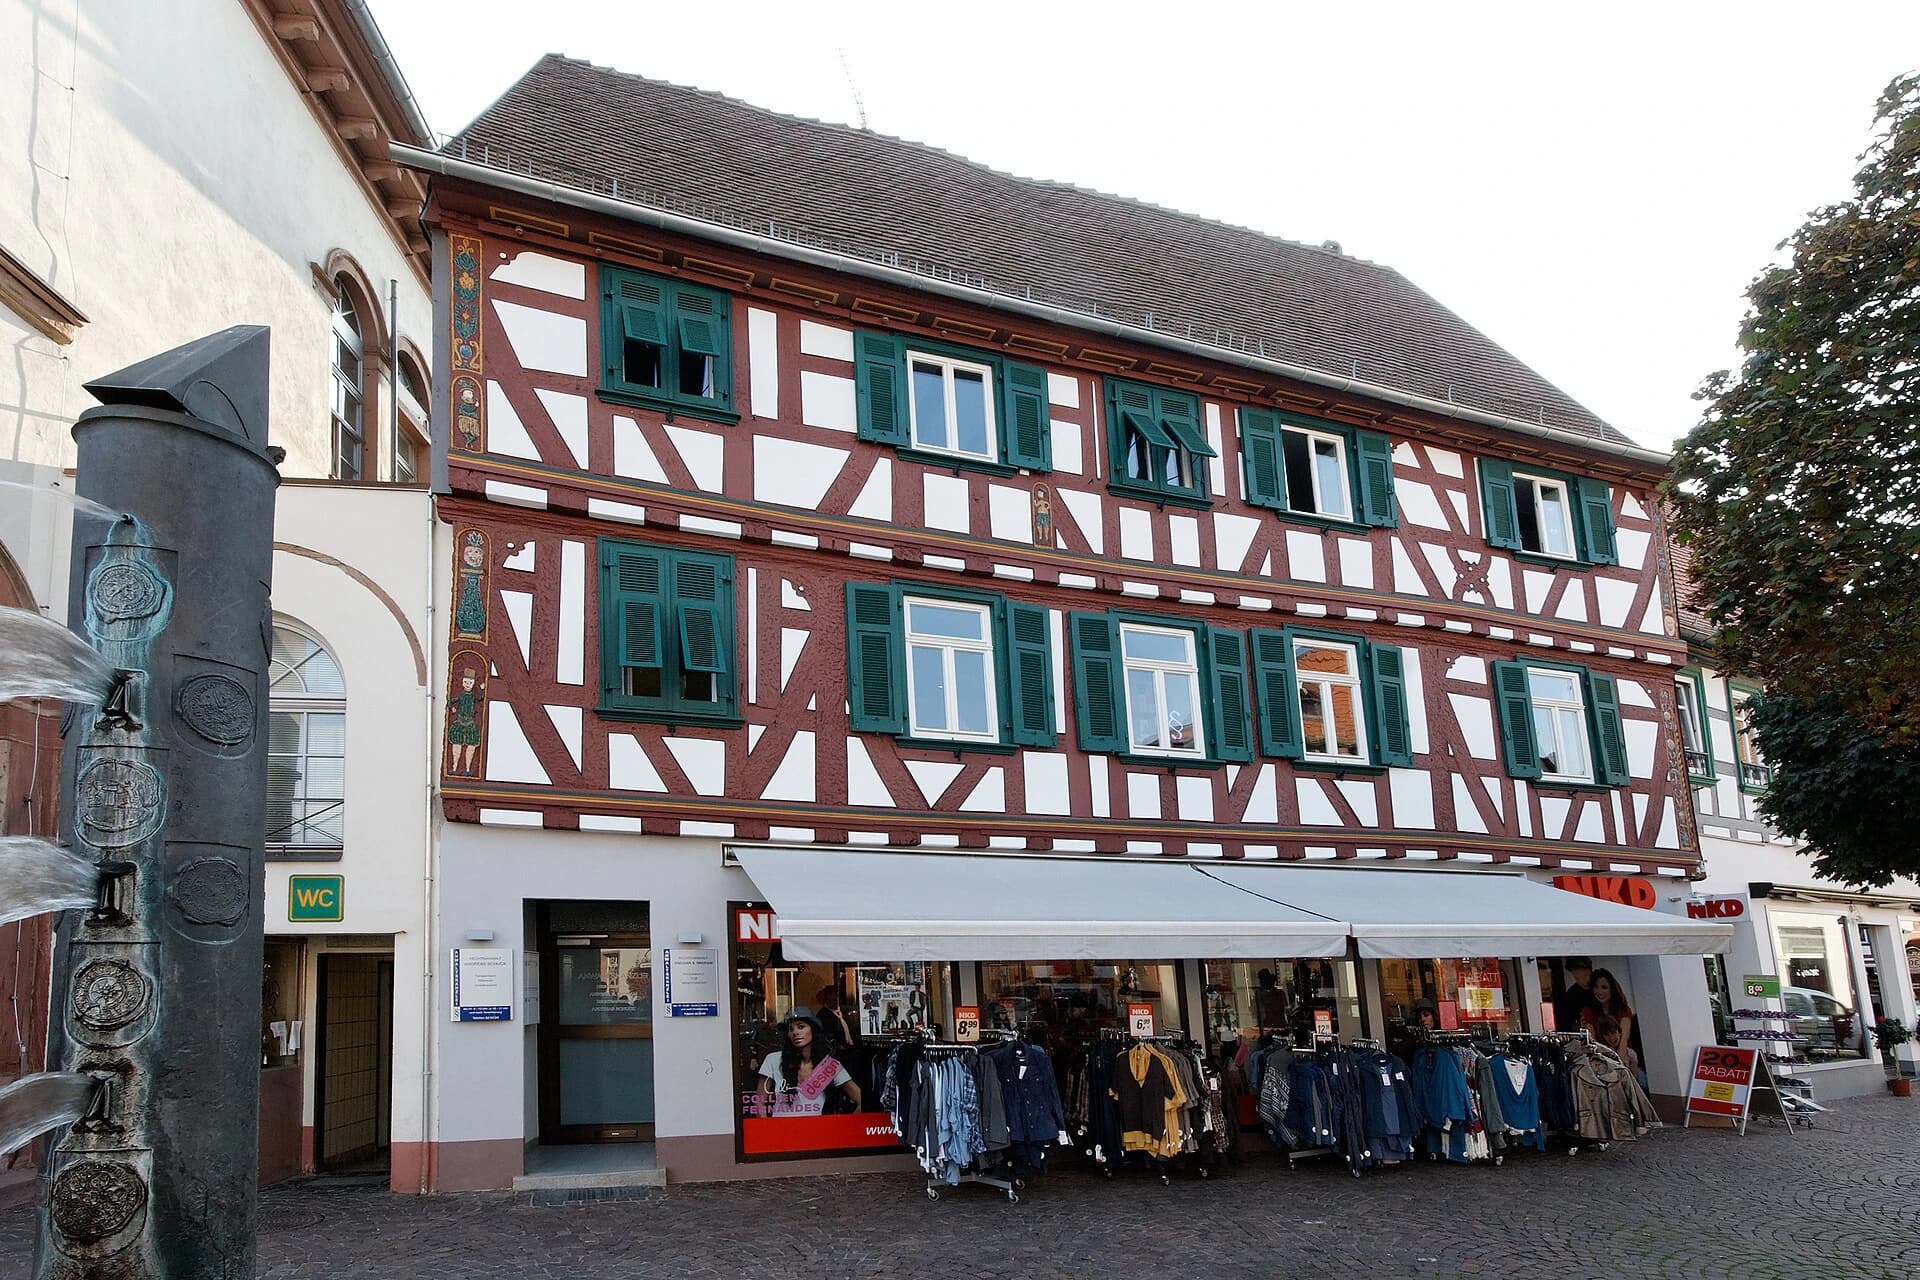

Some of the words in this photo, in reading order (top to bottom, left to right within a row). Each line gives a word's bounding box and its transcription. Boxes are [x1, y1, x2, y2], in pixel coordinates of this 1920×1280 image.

[296, 888, 334, 908] WC
[1553, 875, 1656, 910] NKD
[1686, 899, 1744, 919] NKD
[1458, 972, 1499, 982] RABATT
[957, 1020, 977, 1037] 8,99
[806, 1059, 840, 1095] design
[1697, 1065, 1750, 1080] RABATT
[742, 1103, 820, 1115] FERNANDES
